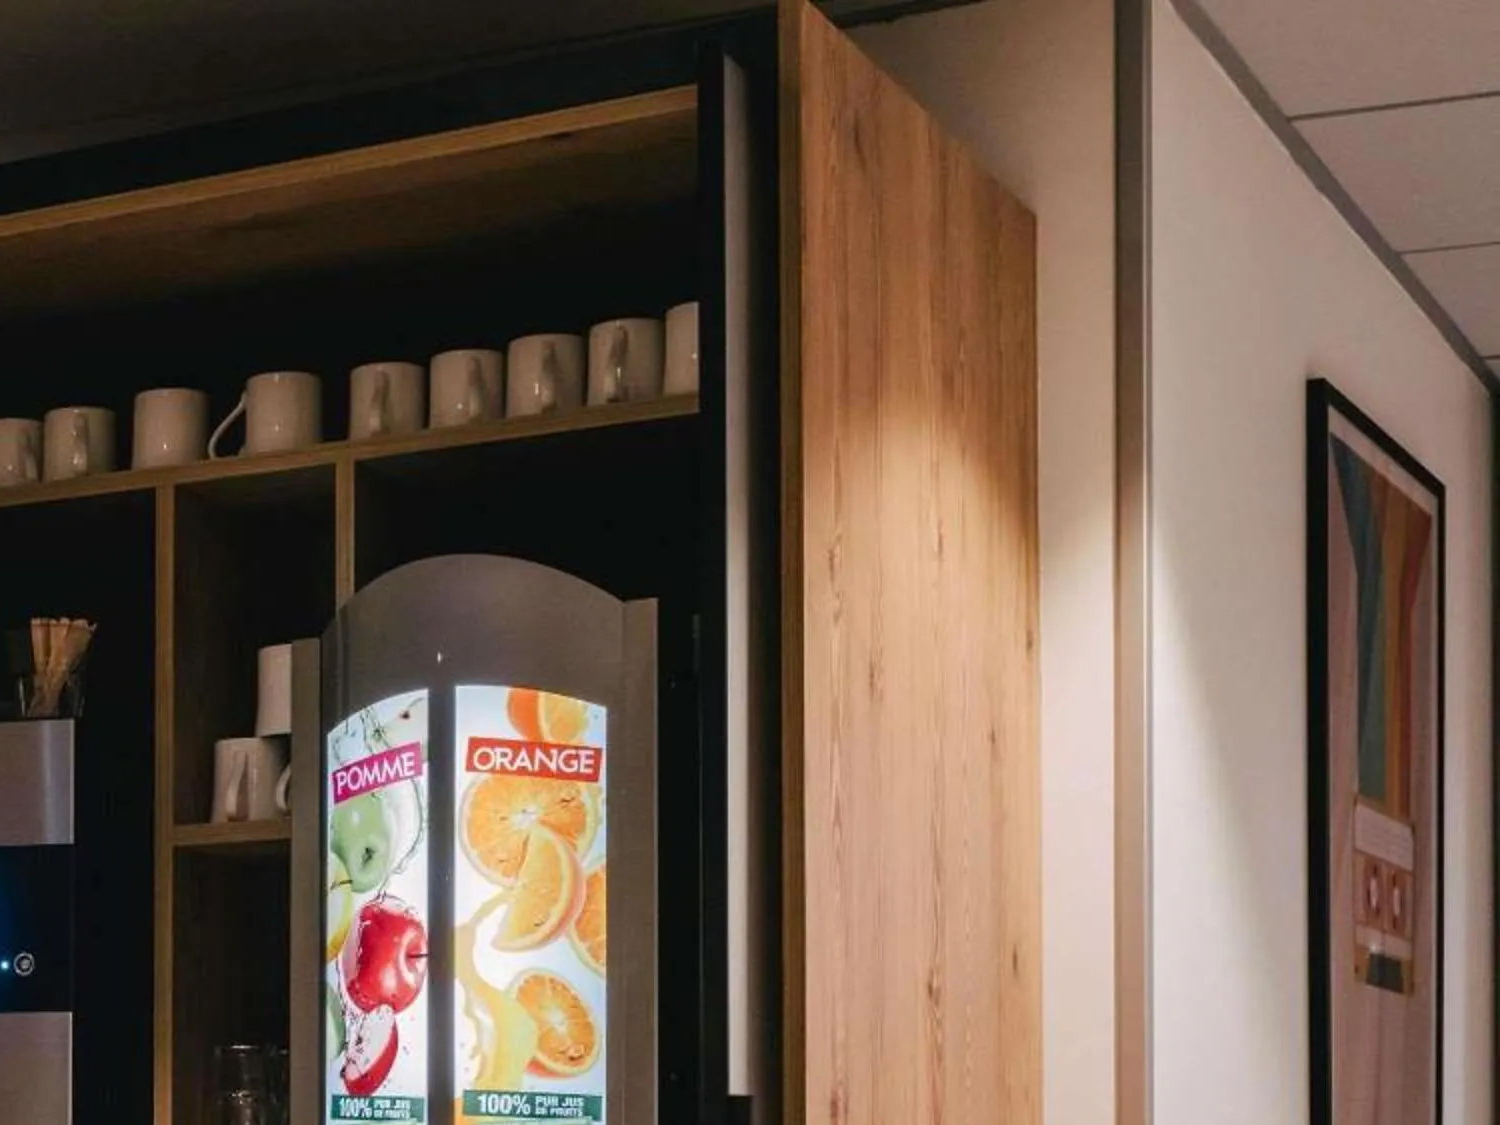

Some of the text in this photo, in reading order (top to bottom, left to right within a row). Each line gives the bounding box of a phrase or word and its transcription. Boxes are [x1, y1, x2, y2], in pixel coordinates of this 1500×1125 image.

[473, 746, 595, 774] ORANGE
[336, 752, 415, 795] POMME
[340, 1097, 373, 1118] 100%
[477, 1093, 531, 1115] 100%
[535, 1095, 584, 1107] PUR JUS
